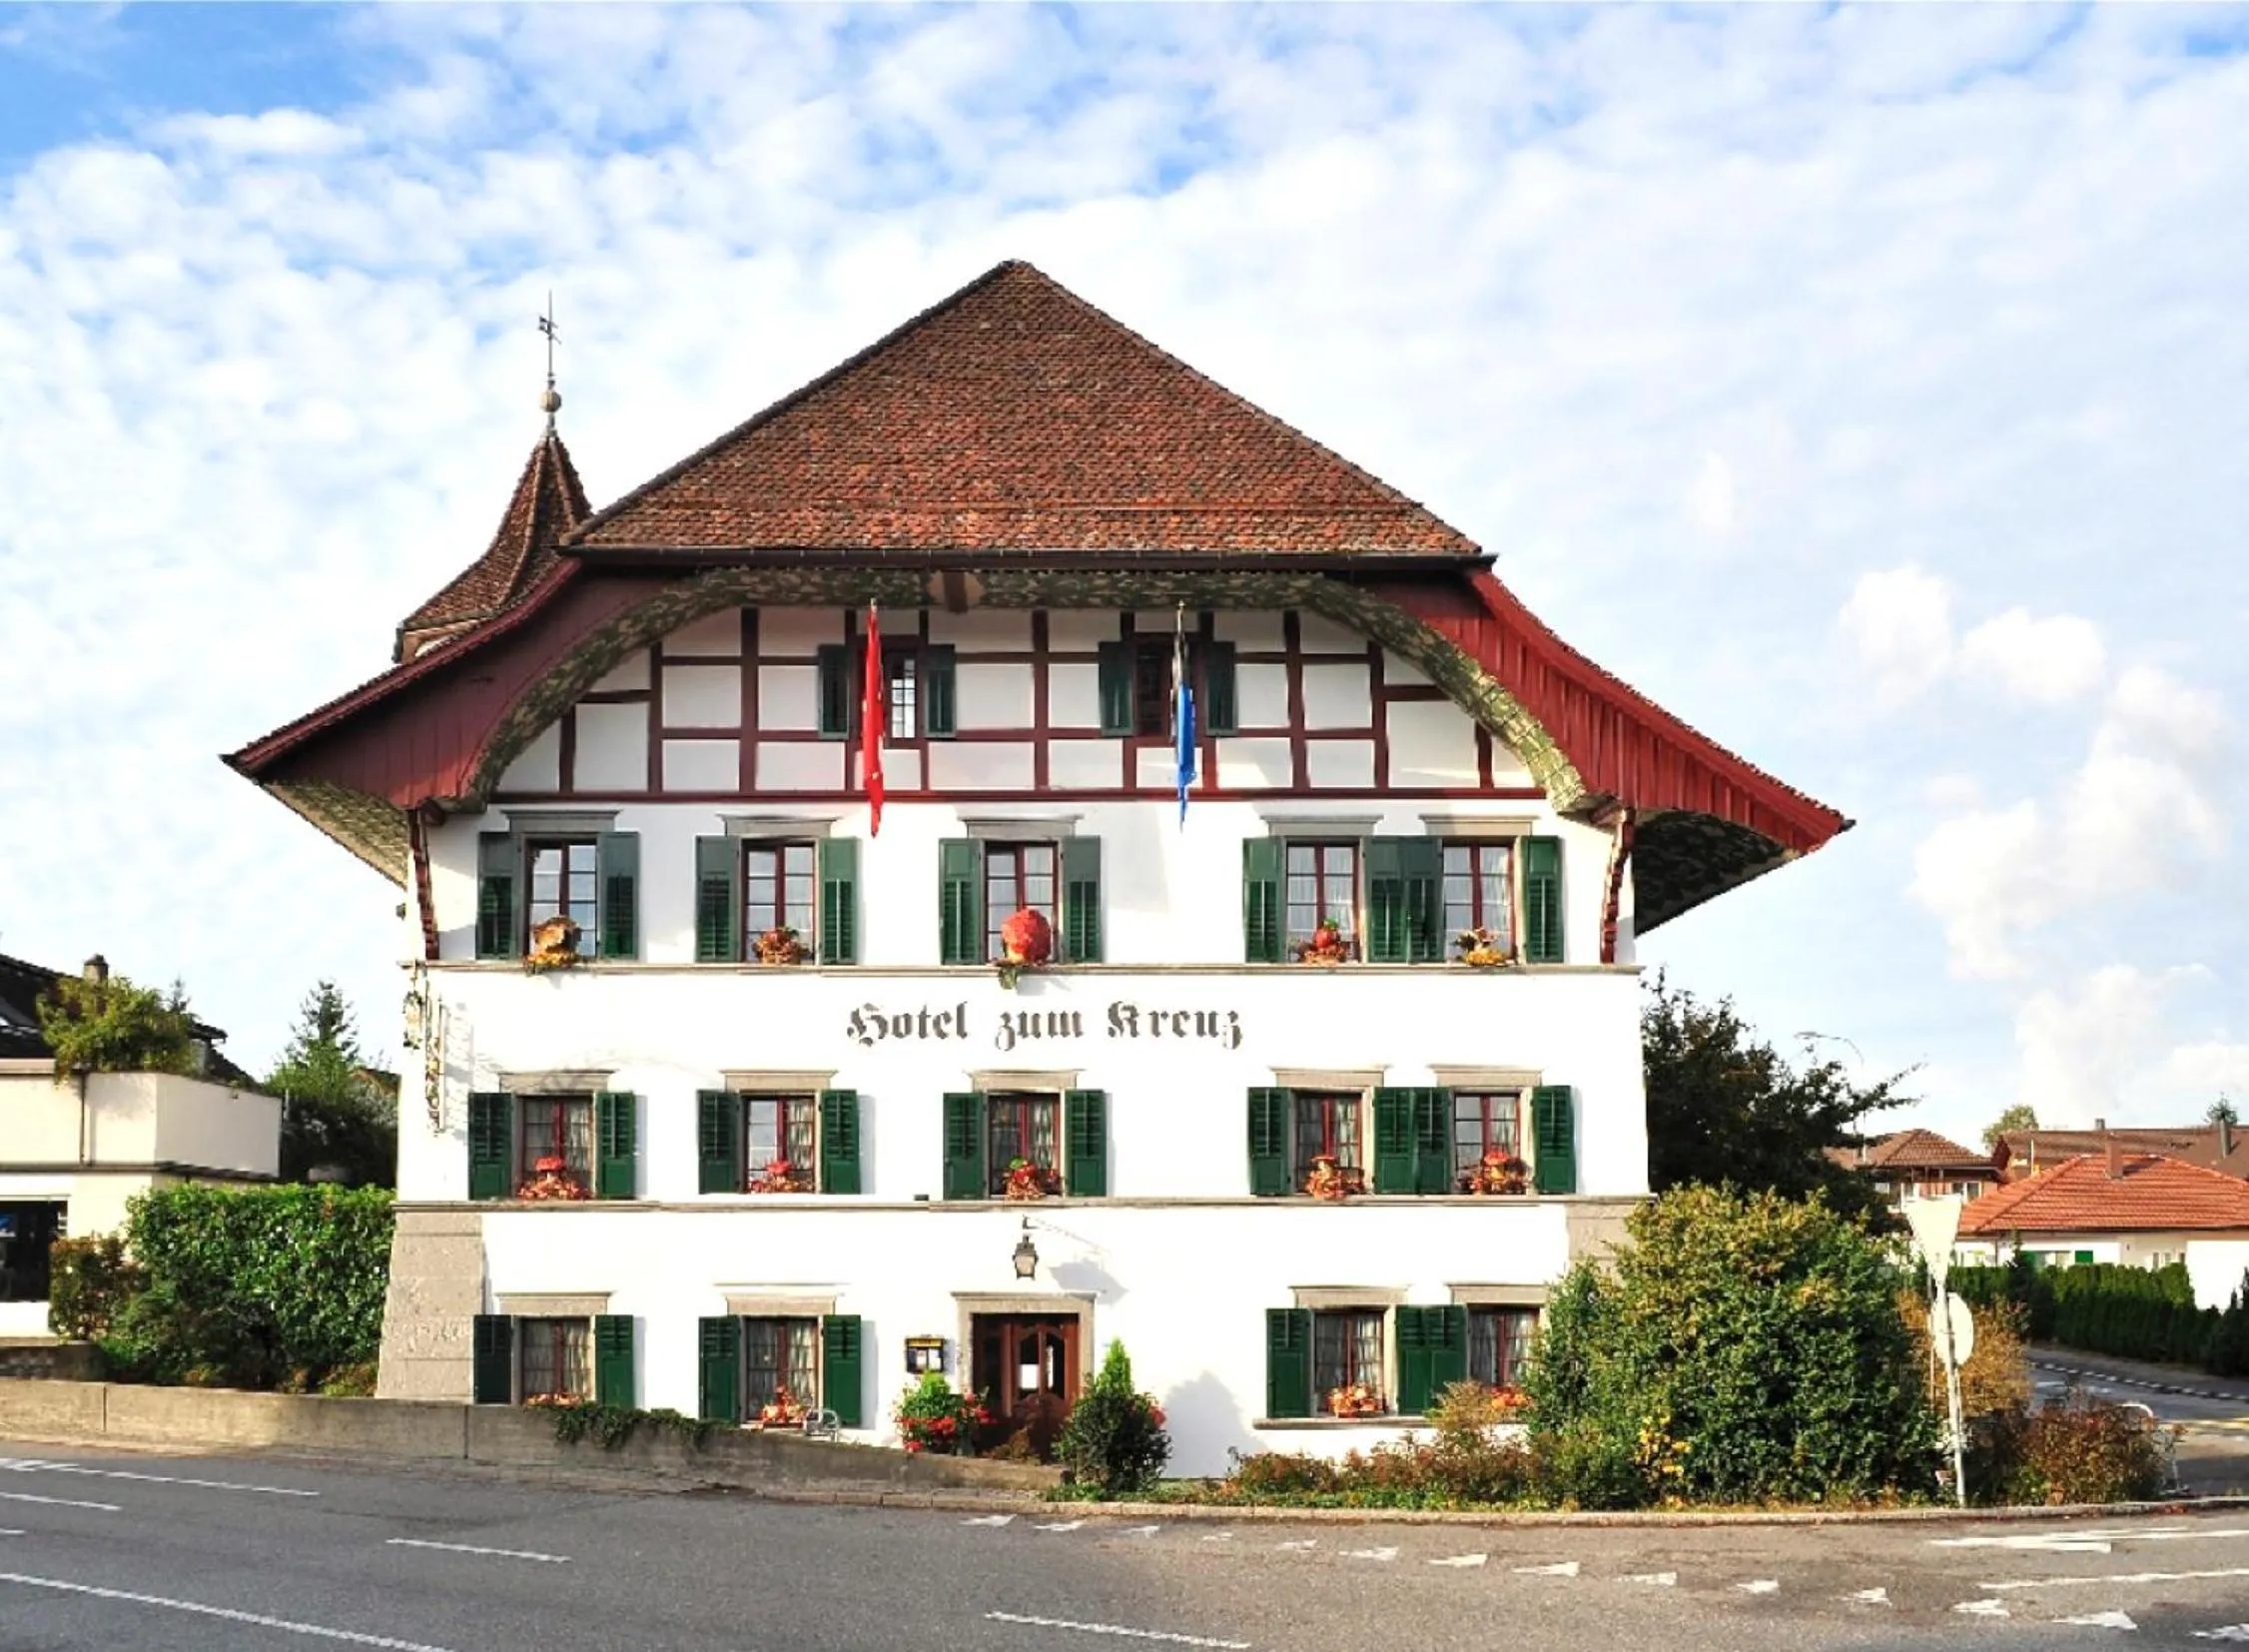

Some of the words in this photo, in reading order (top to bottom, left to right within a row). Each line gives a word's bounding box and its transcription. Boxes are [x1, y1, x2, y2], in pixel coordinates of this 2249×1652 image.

[847, 1002, 968, 1047] Hotel
[996, 1011, 1083, 1051] zum
[1108, 1001, 1242, 1050] Kreuz
